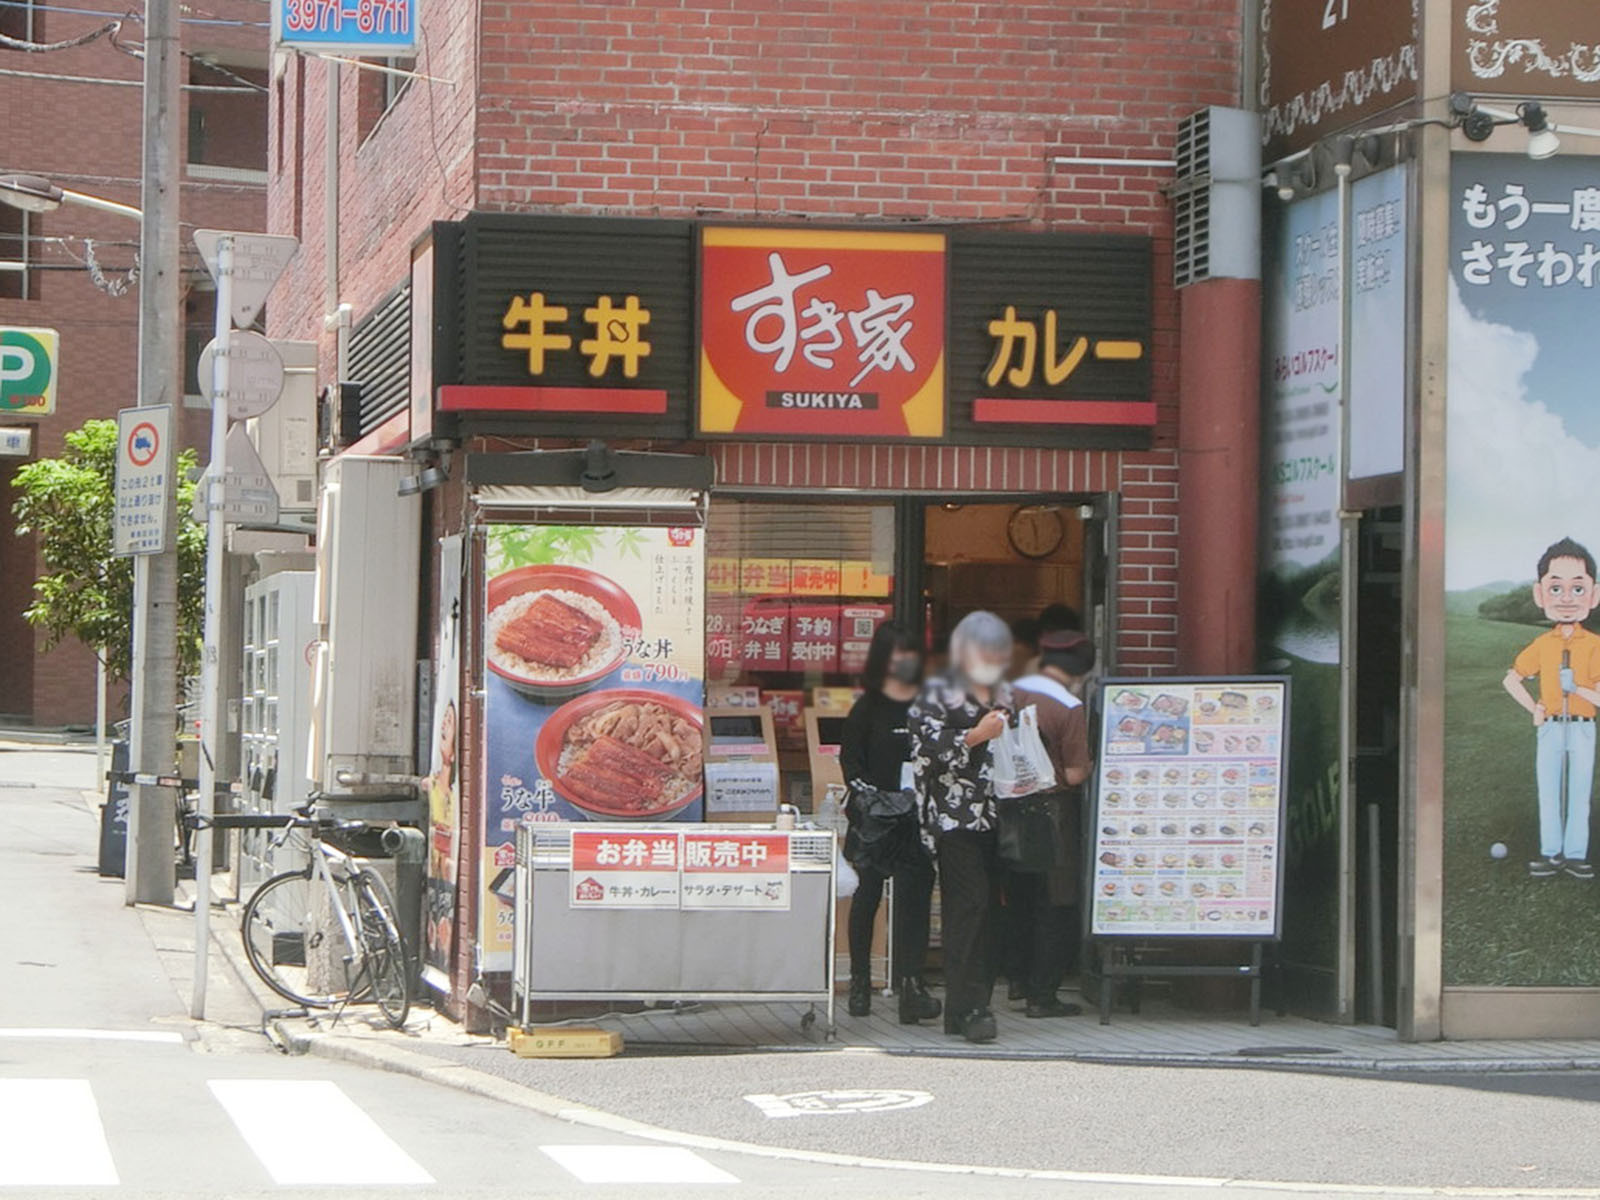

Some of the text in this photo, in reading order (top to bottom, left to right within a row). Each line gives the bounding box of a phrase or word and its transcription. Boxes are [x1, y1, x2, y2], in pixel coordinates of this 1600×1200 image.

[287, 0, 408, 32] 3971-8711
[1462, 183, 1600, 231] もう一度
[1461, 240, 1600, 287] さそわれ
[502, 293, 651, 378] 牛丼
[732, 252, 916, 388] すき家
[986, 305, 1142, 388] カレー
[781, 392, 863, 409] SUKIYA
[796, 617, 832, 636] 予約
[745, 641, 780, 660] 弁当
[792, 641, 836, 660] 受付中
[596, 839, 767, 868] お弁当販売中
